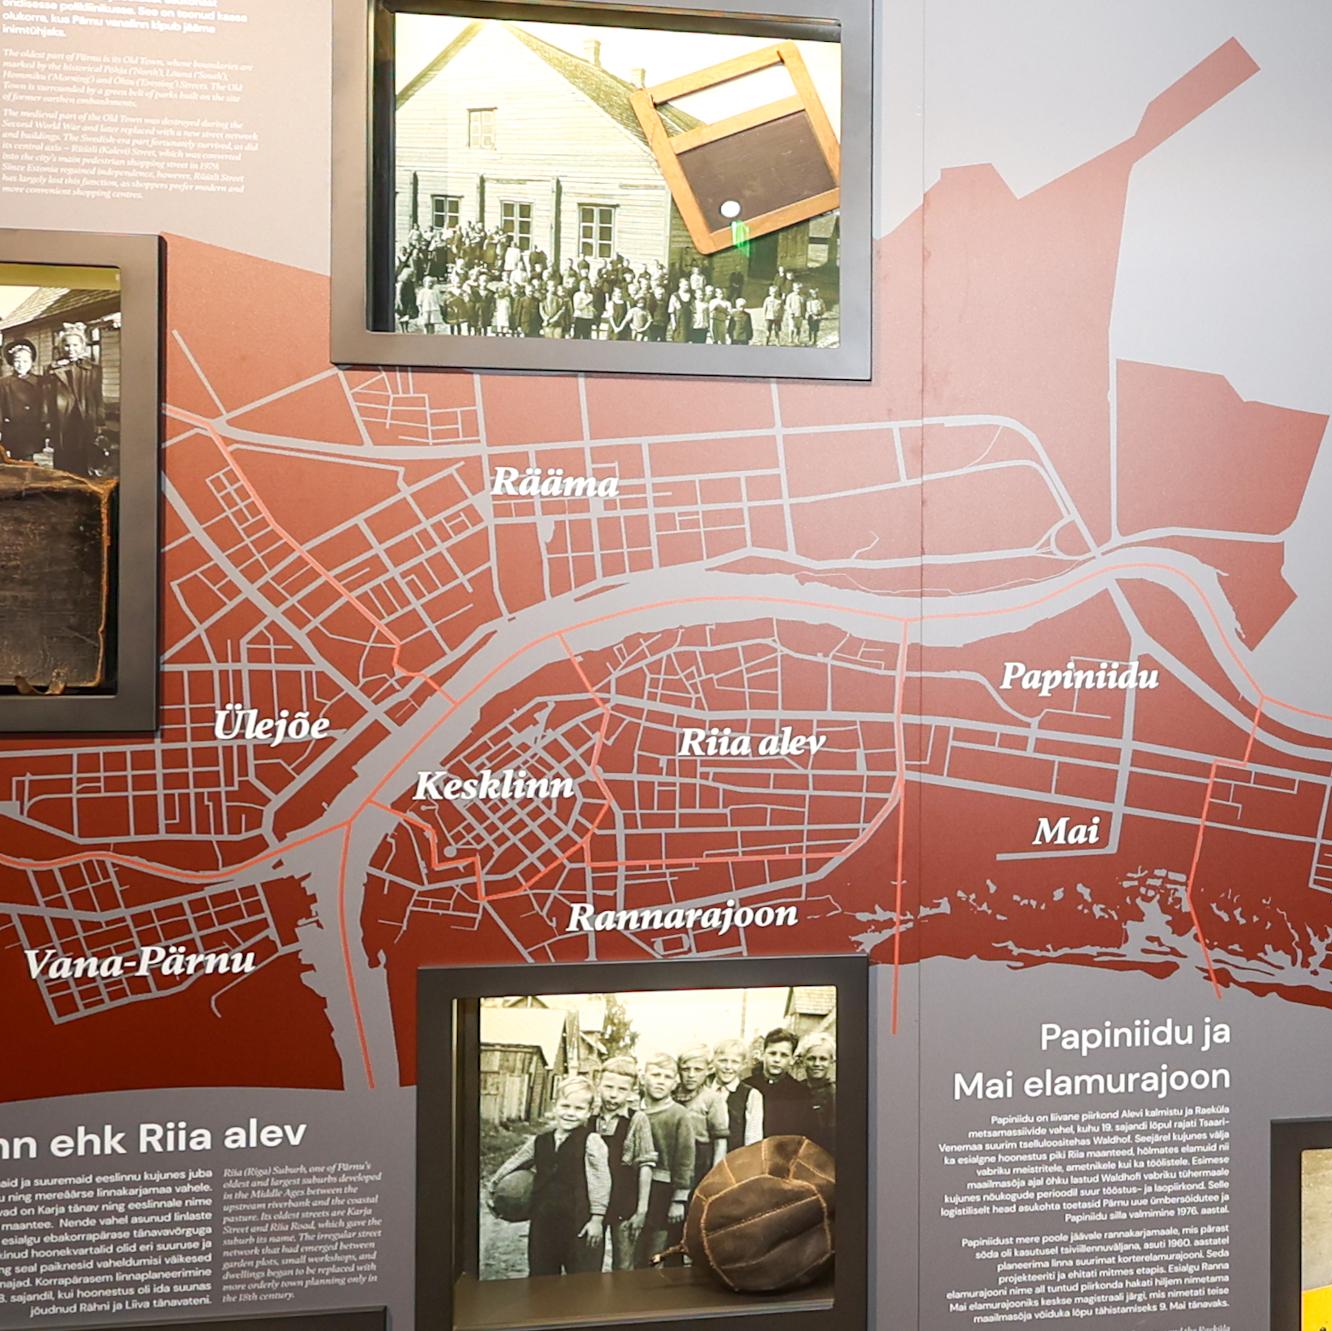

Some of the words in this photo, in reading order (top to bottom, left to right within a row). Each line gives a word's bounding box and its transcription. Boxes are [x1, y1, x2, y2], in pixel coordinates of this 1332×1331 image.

[491, 466, 620, 499] Rääma
[1000, 661, 1159, 697] Papiniidu
[213, 703, 331, 747] Ülejõe
[678, 727, 752, 757] Riia
[757, 727, 827, 756] alev
[413, 770, 575, 801] Kesklinn
[1032, 817, 1100, 846] Mai
[566, 901, 799, 934] Rannarajoon
[24, 945, 256, 980] Vana-Pärnu
[1041, 1018, 1193, 1056] Papiniidu
[1200, 1017, 1231, 1051] ja
[954, 1071, 1014, 1100] Mai
[1024, 1064, 1231, 1099] elamurajoon
[50, 1124, 127, 1157] ehk
[139, 1120, 212, 1153] Riia
[224, 1118, 307, 1149] alev
[143, 1169, 185, 1182] kujunes
[188, 1167, 212, 1180] juba
[8, 1190, 31, 1203] ning
[175, 1182, 212, 1193] vahele.
[59, 1216, 96, 1227] Nende
[99, 1214, 128, 1225] vahel
[130, 1212, 171, 1224] asunud
[30, 1303, 76, 1316] jõudnud
[79, 1300, 109, 1311] Rähni
[125, 1298, 149, 1309] Liiva
